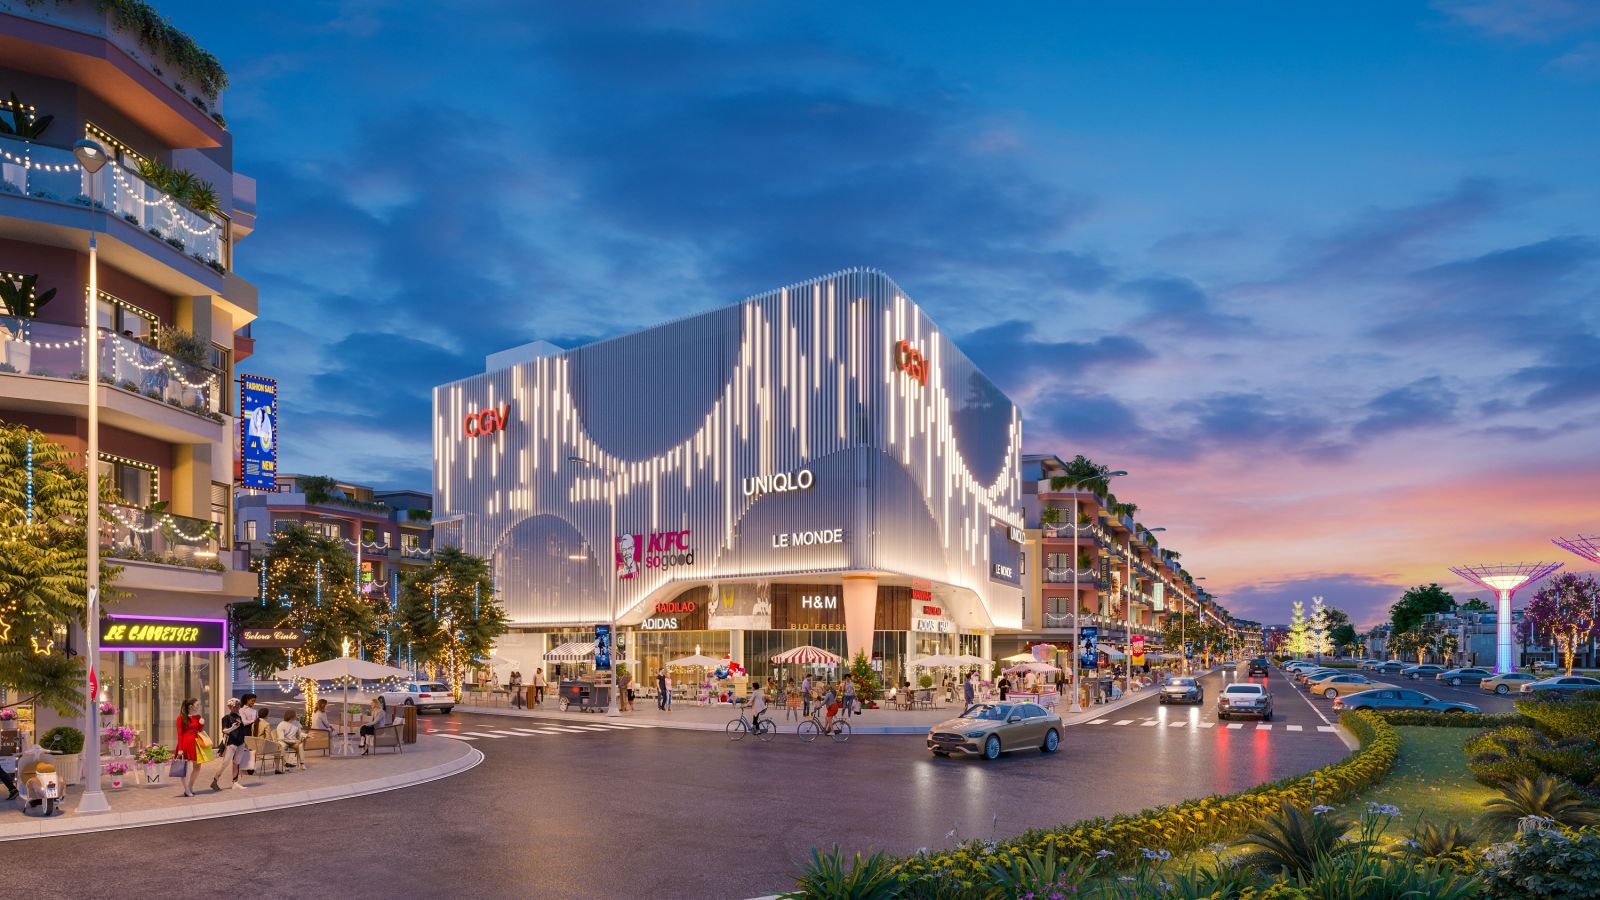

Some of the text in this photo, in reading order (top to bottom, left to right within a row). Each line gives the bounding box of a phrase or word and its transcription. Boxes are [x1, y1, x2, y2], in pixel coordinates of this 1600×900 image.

[896, 339, 931, 388] CGV
[246, 381, 275, 394] FASHION SALE
[464, 404, 511, 438] CGV
[262, 460, 274, 471] NEW
[743, 469, 813, 496] UNIQLO
[647, 530, 692, 552] KFC
[773, 529, 843, 548] LE MONDE
[655, 601, 696, 614] HAIDILAO
[802, 595, 837, 609] H&M
[641, 617, 678, 630] ADIDAS
[103, 625, 127, 641] LE
[244, 631, 271, 640] Gelora
[147, 774, 160, 783] M
